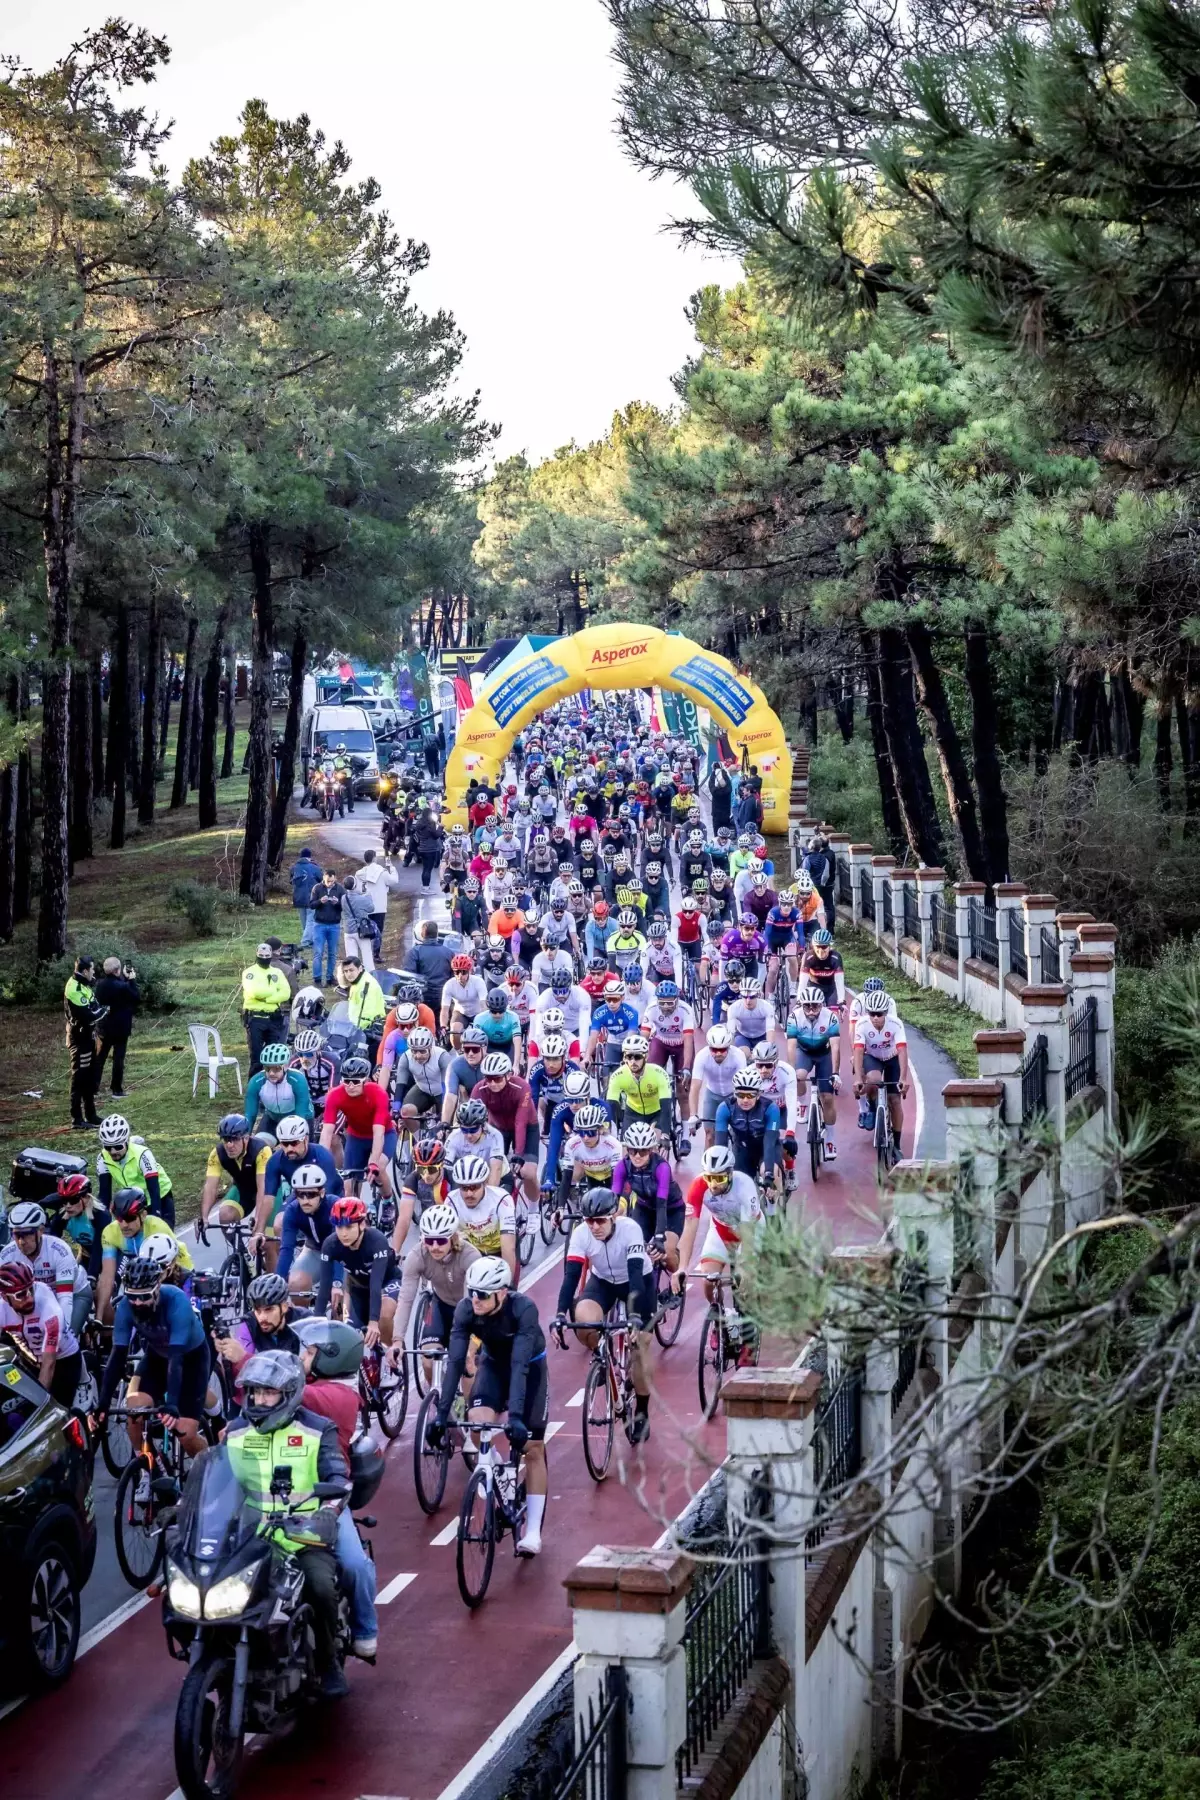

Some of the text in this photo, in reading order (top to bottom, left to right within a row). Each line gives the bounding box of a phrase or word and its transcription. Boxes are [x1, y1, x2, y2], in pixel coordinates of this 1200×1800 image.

[591, 643, 648, 664] Asperox
[466, 732, 497, 742] Asperox
[742, 731, 773, 742] Asperox
